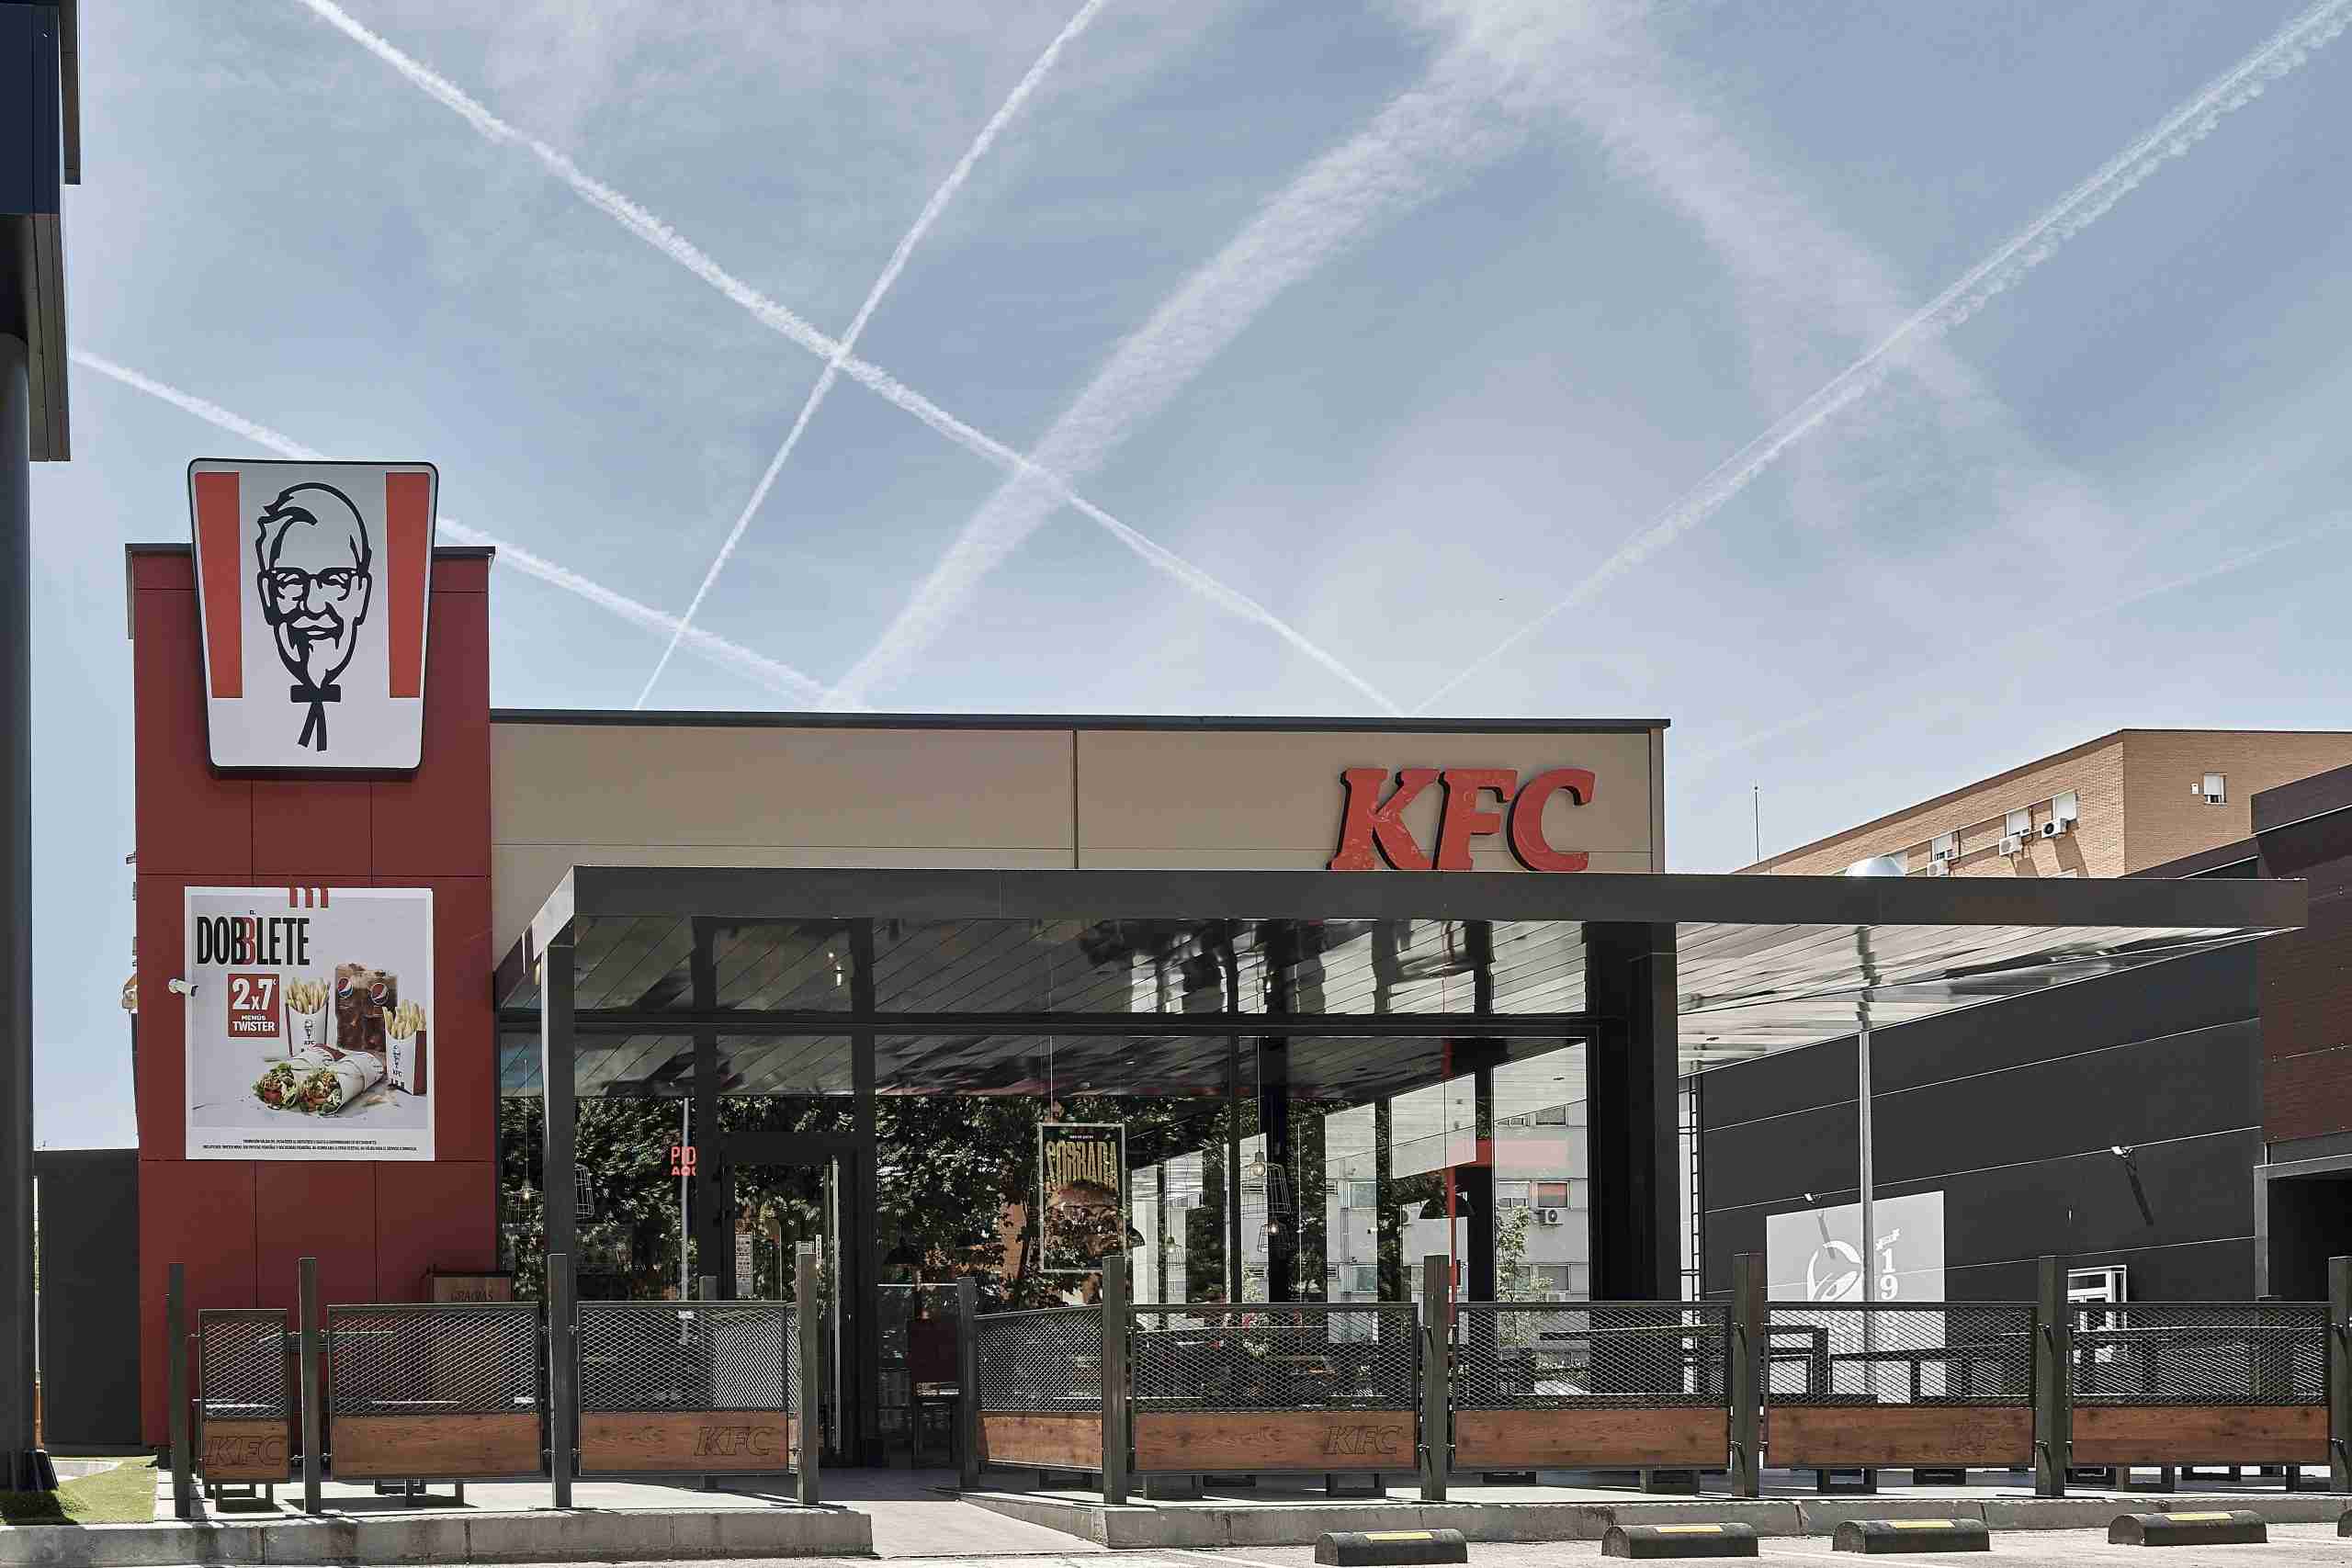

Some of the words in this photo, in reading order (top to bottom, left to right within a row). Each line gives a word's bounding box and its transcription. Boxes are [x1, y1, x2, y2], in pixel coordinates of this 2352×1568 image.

[1326, 768, 1596, 872] KFC
[232, 1021, 275, 1032] TWISTER
[671, 1145, 696, 1165] PID
[205, 1436, 285, 1466] KFC
[693, 1425, 776, 1457] KFC
[1322, 1425, 1404, 1455] KFC
